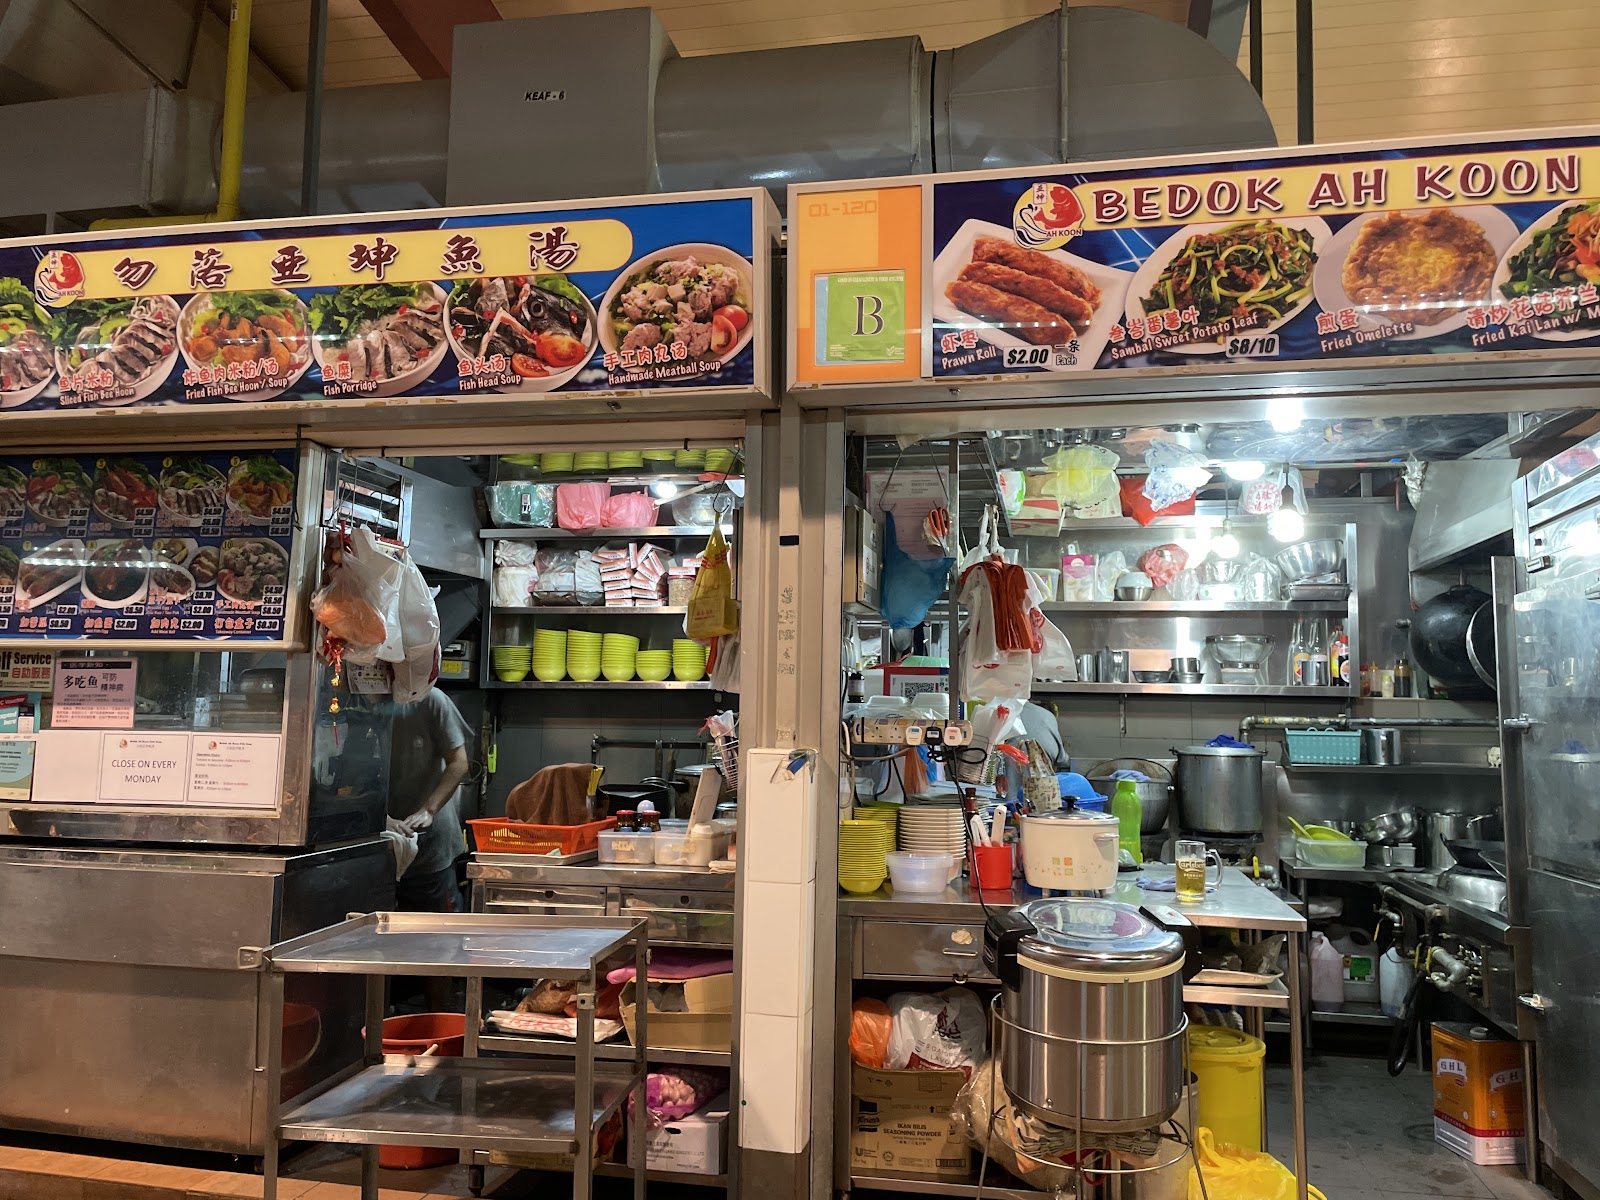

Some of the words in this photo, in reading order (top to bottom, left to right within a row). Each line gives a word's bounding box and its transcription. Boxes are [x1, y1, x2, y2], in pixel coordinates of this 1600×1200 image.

[525, 91, 551, 101] KEAF
[559, 90, 565, 100] 6
[1092, 176, 1284, 223] BEDOK
[1307, 167, 1387, 209] AH
[1415, 154, 1580, 200] KOON
[808, 199, 878, 218] 01-120
[1059, 229, 1082, 237] KOON
[852, 295, 884, 336] B
[1315, 307, 1359, 335] 煎蛋
[1472, 328, 1505, 346] Fried
[1508, 321, 1532, 338] Kai
[1535, 318, 1560, 331] Lan
[1563, 308, 1581, 325] w/
[941, 328, 978, 353] 虾枣
[1111, 337, 1153, 360] Sambal
[1155, 331, 1190, 349] Sweet
[1193, 321, 1231, 339] Potato
[1232, 312, 1258, 329] Leaf
[1321, 335, 1352, 352] Fried
[1356, 322, 1413, 344] Omelette
[1055, 339, 1080, 353] 一条
[1228, 337, 1276, 355] $8/10
[457, 353, 506, 376] 鱼头汤
[603, 341, 688, 371] 手工肉丸汤
[942, 354, 975, 370] Prawn
[976, 345, 997, 361] Roll
[1007, 348, 1049, 366] $2.00
[1055, 354, 1078, 366] Each
[183, 357, 279, 386] 炸鱼肉米粉/汤
[608, 370, 654, 386] Handmade
[656, 362, 697, 379] Meatball
[699, 360, 721, 372] Soup
[57, 369, 115, 392] 鱼片米粉
[185, 388, 206, 400] Fried
[207, 385, 223, 397] Fish
[224, 383, 238, 394] Bee
[240, 380, 259, 392] Hoon
[268, 377, 288, 389] Soup
[323, 384, 340, 396] Fish
[342, 381, 377, 393] Porridge
[459, 378, 476, 391] Fish
[478, 375, 499, 388] Head
[500, 374, 521, 385] Soup
[60, 393, 83, 406] Sliced
[83, 391, 99, 403] Fish
[100, 389, 113, 400] Bee
[115, 386, 135, 398] Hoon
[272, 507, 291, 516] $4.50
[264, 586, 283, 595] $4.50
[193, 605, 212, 614] $2.00
[115, 620, 136, 629] $2.00
[181, 620, 202, 629] $2.00
[256, 620, 278, 630] $0.30
[14, 651, 52, 665] Service
[64, 675, 98, 689] 多吃鱼
[111, 760, 136, 768] CLOSE
[137, 760, 150, 768] ON
[152, 760, 177, 769] EVERY
[125, 775, 161, 783] MONDAY
[1440, 1061, 1463, 1072] GHL
[1495, 1071, 1518, 1084] GH
[883, 1128, 915, 1136] SEASONING
